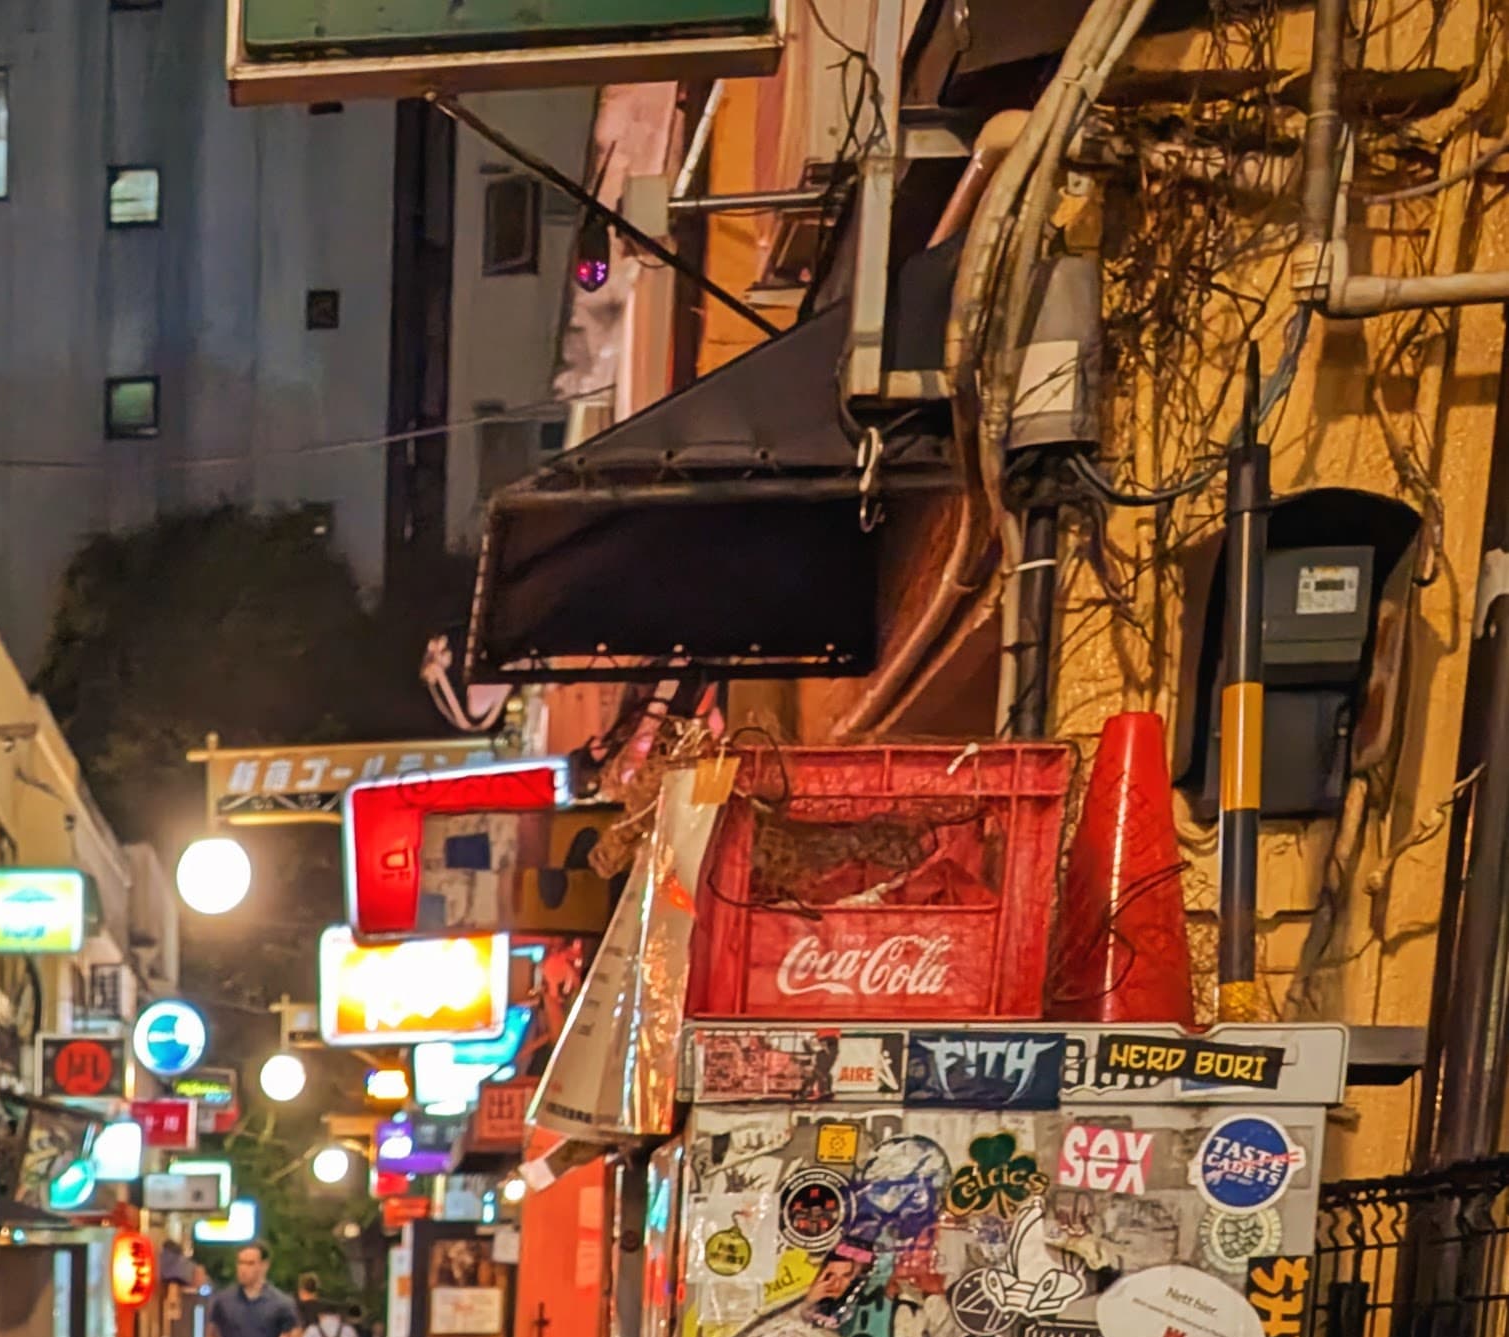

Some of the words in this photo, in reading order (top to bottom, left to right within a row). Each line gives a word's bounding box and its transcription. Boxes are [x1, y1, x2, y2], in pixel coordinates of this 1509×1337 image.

[777, 935, 953, 996] Coca-Cola
[1205, 1153, 1281, 1186] CADETS
[1212, 1136, 1285, 1174] TASTE
